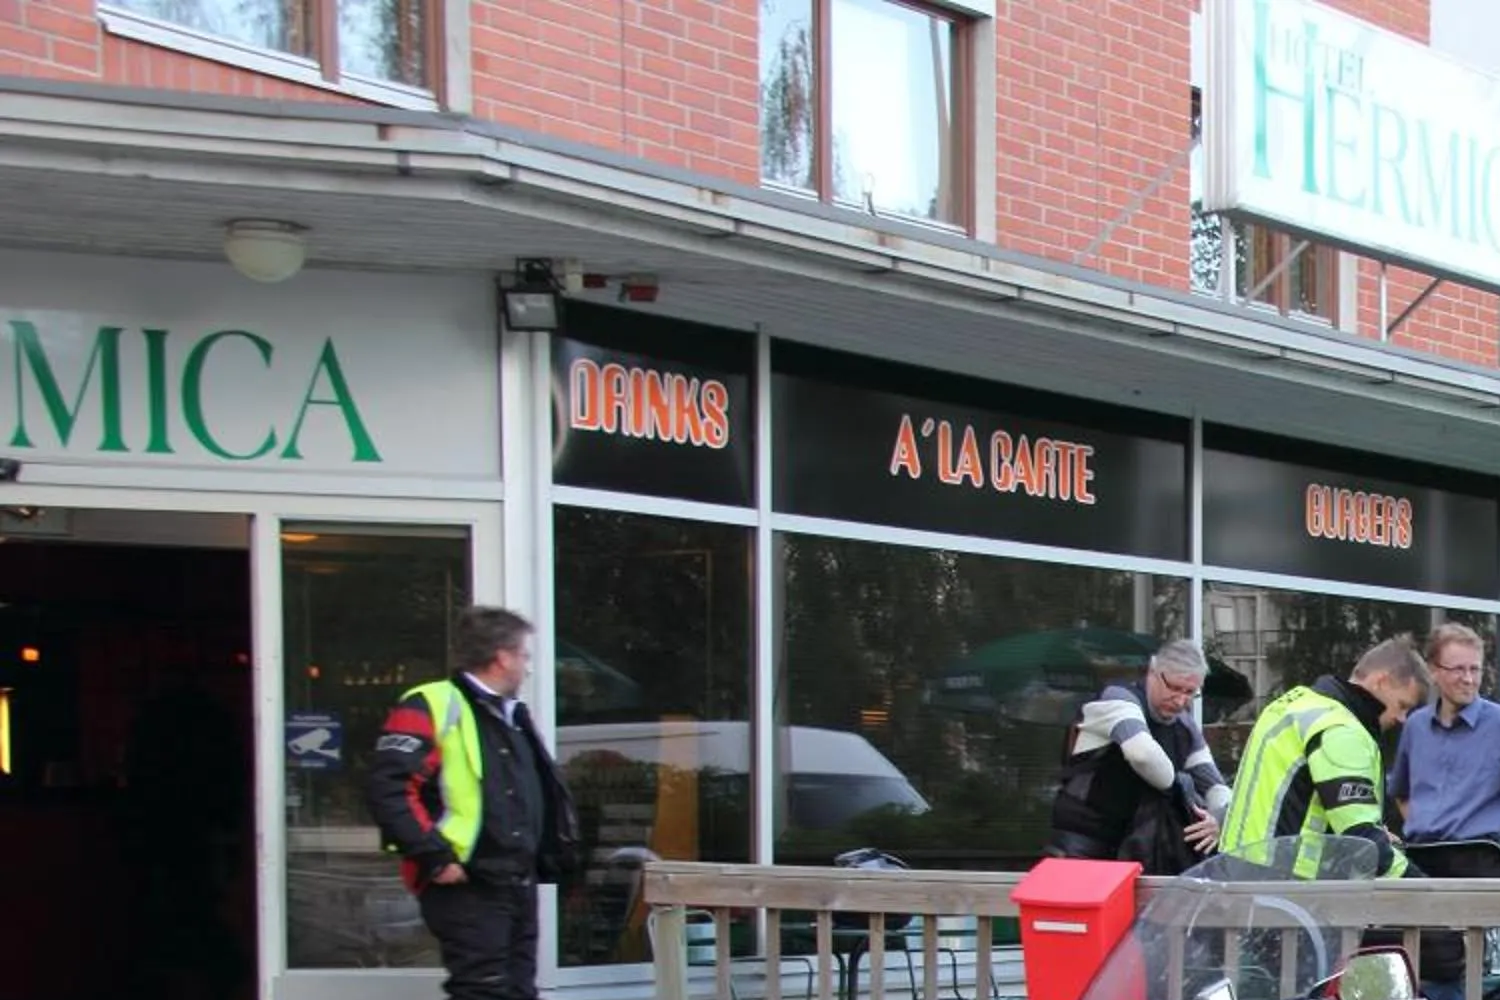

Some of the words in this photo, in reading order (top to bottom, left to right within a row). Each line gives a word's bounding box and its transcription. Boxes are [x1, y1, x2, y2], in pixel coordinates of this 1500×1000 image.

[8, 320, 383, 462] MICA
[570, 358, 728, 449] DRINKS
[990, 430, 1096, 505] CARTE
[1306, 483, 1413, 549] BURGERS
